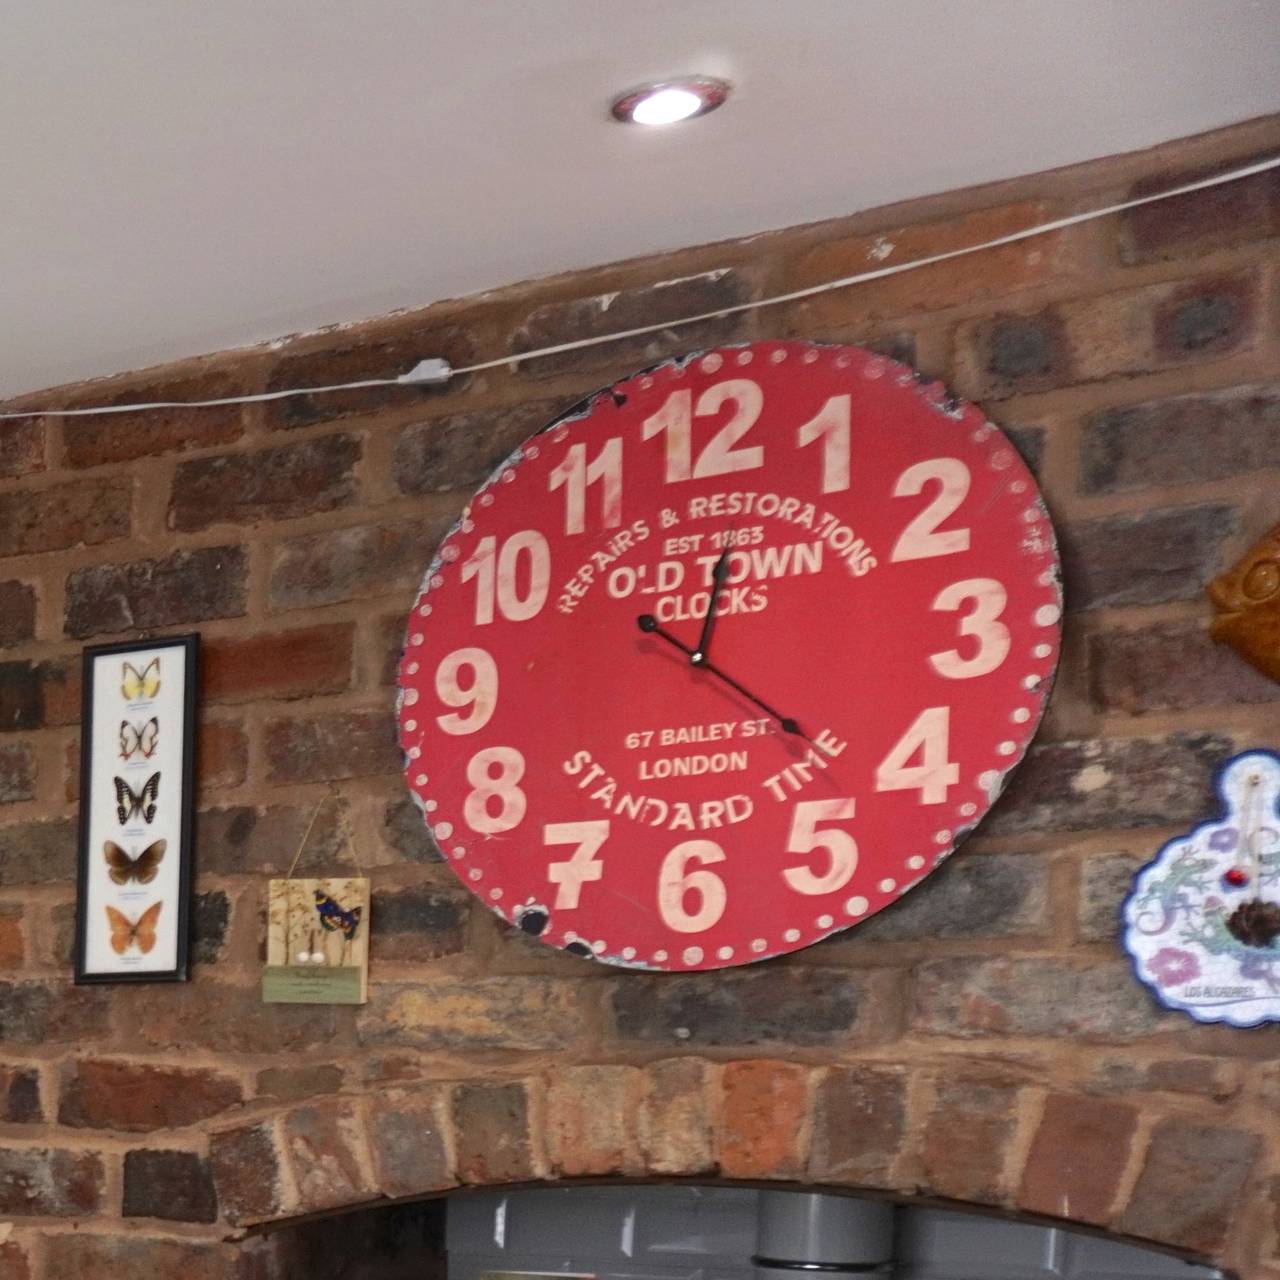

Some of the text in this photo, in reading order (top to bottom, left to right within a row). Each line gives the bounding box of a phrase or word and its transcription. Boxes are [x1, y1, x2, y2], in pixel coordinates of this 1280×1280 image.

[642, 378, 765, 483] 12
[797, 394, 852, 494] 1
[548, 436, 623, 535] 11
[889, 457, 972, 563] 2
[460, 529, 551, 626] 10
[558, 492, 878, 613] REPAIRS & RESTORATIONS
[608, 541, 823, 599] OLD TOWN
[663, 525, 765, 556] EST 1863
[655, 585, 769, 622] CLOCKS
[928, 577, 1012, 680] 3
[435, 647, 499, 735] 9
[625, 731, 654, 749] 67
[660, 722, 737, 746] BAILEY
[462, 745, 527, 833] 8
[563, 729, 847, 831] STANDARD TIME
[639, 751, 748, 780] LONDON
[875, 706, 960, 805] 4
[543, 820, 610, 910] 7
[657, 839, 727, 933] 6
[783, 797, 859, 896] 5
